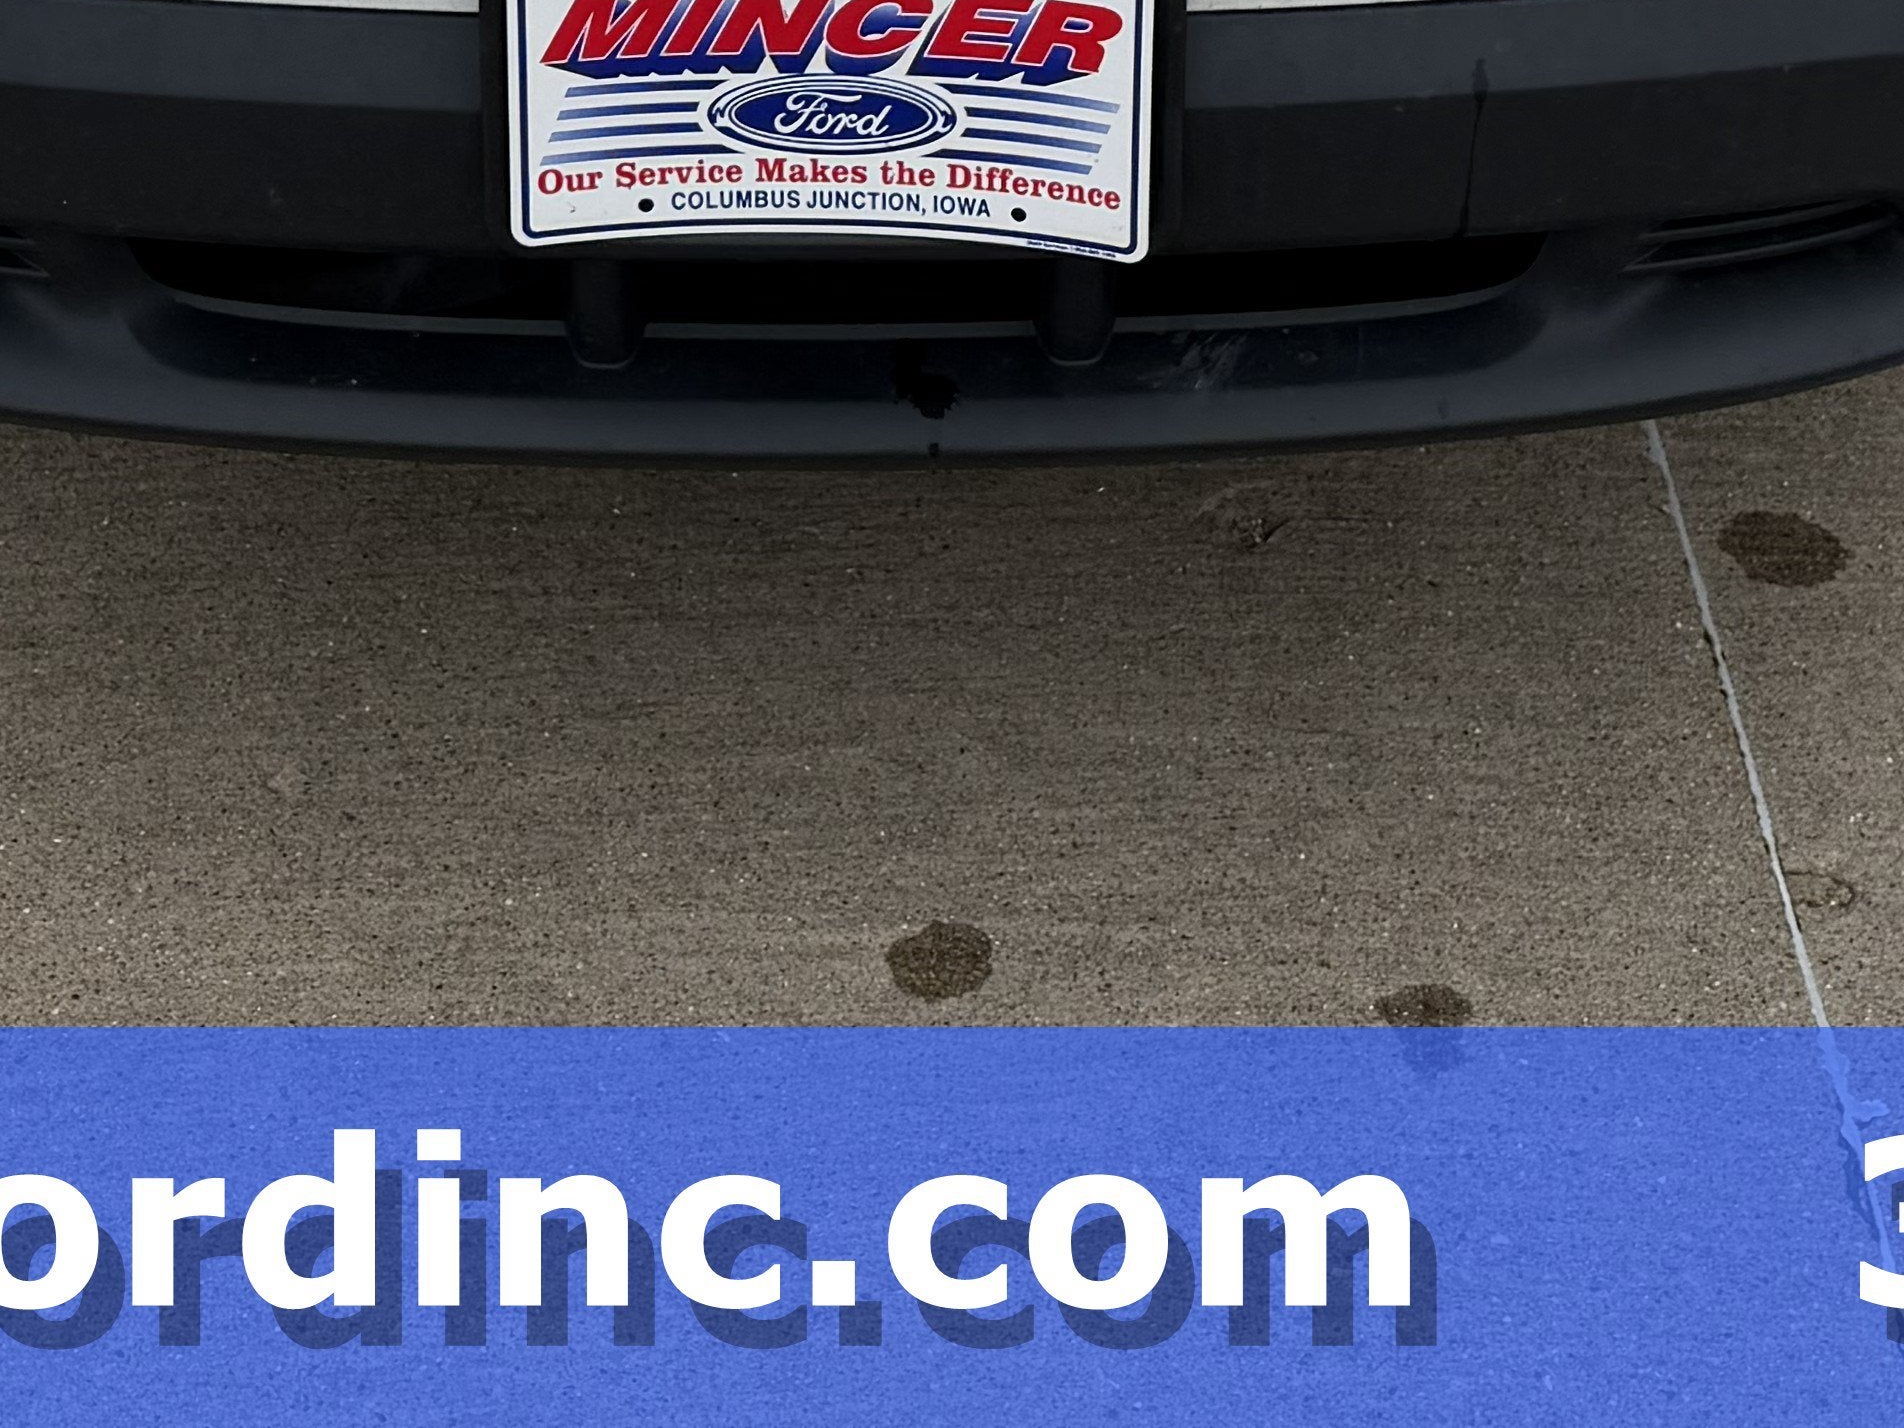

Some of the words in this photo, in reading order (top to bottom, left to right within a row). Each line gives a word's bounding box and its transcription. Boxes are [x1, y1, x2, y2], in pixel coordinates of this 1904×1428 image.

[773, 91, 892, 136] Ford
[537, 167, 603, 195] Our
[615, 158, 743, 190] Service
[755, 157, 868, 185] Makes
[880, 160, 936, 187] the
[946, 163, 1121, 210] Difference
[671, 190, 801, 211] COLUMBUS
[806, 190, 927, 216] JUNCTION,
[933, 195, 991, 218] IOWA
